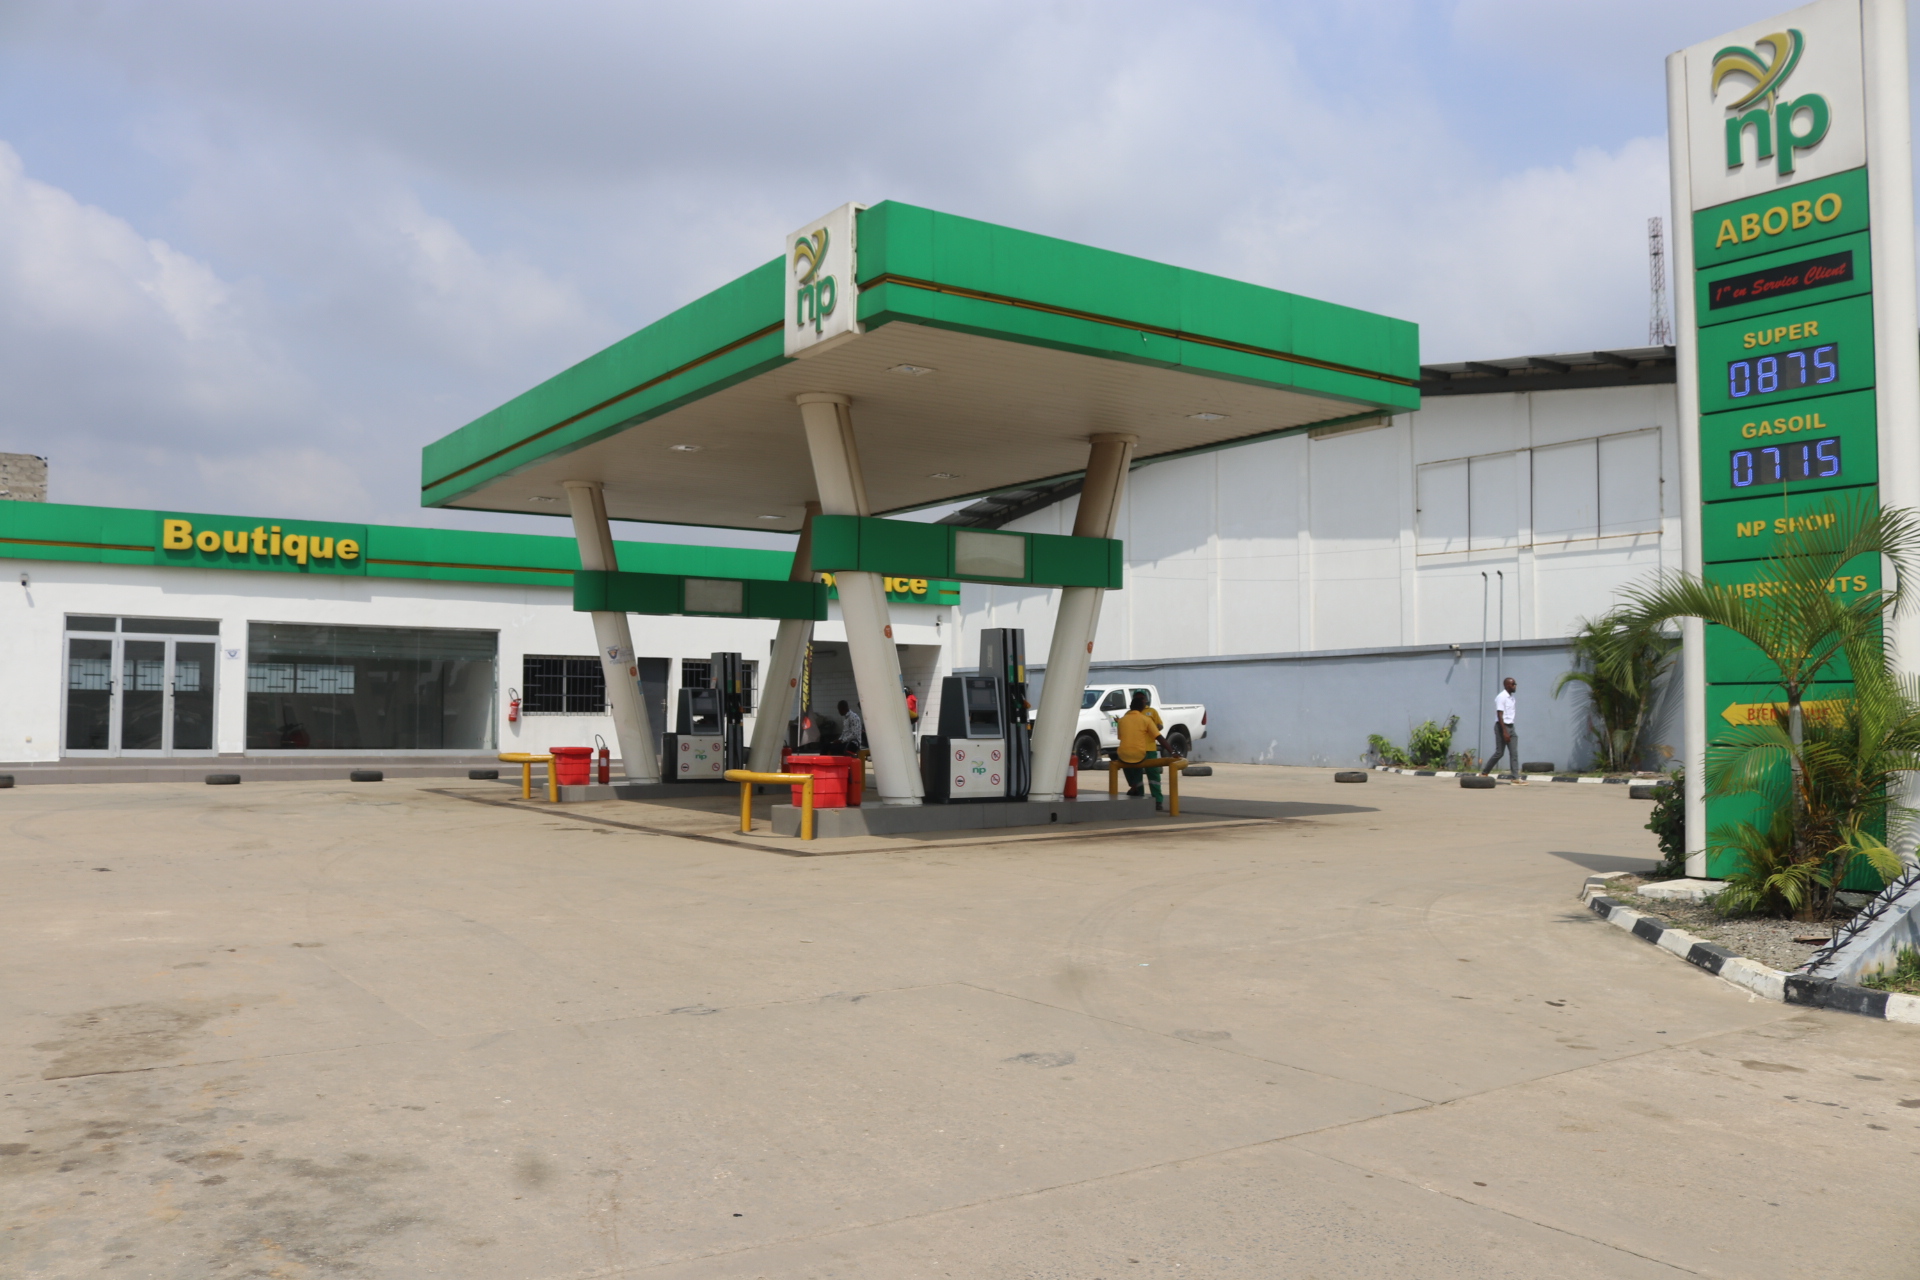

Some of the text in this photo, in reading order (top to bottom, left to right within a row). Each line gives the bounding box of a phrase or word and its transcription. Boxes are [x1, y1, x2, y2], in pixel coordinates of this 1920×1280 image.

[1725, 92, 1831, 177] np
[1715, 192, 1843, 249] ABOBO
[1733, 287, 1747, 298] en
[1751, 275, 1799, 296] Service
[1803, 262, 1847, 286] Client
[796, 274, 838, 334] np
[1743, 320, 1819, 349] SUPER
[1729, 346, 1837, 398] 0875
[1741, 412, 1827, 439] GASOIL
[1732, 439, 1839, 487] 0715
[162, 518, 360, 565] Boutique
[1736, 513, 1836, 538] NP SHOP
